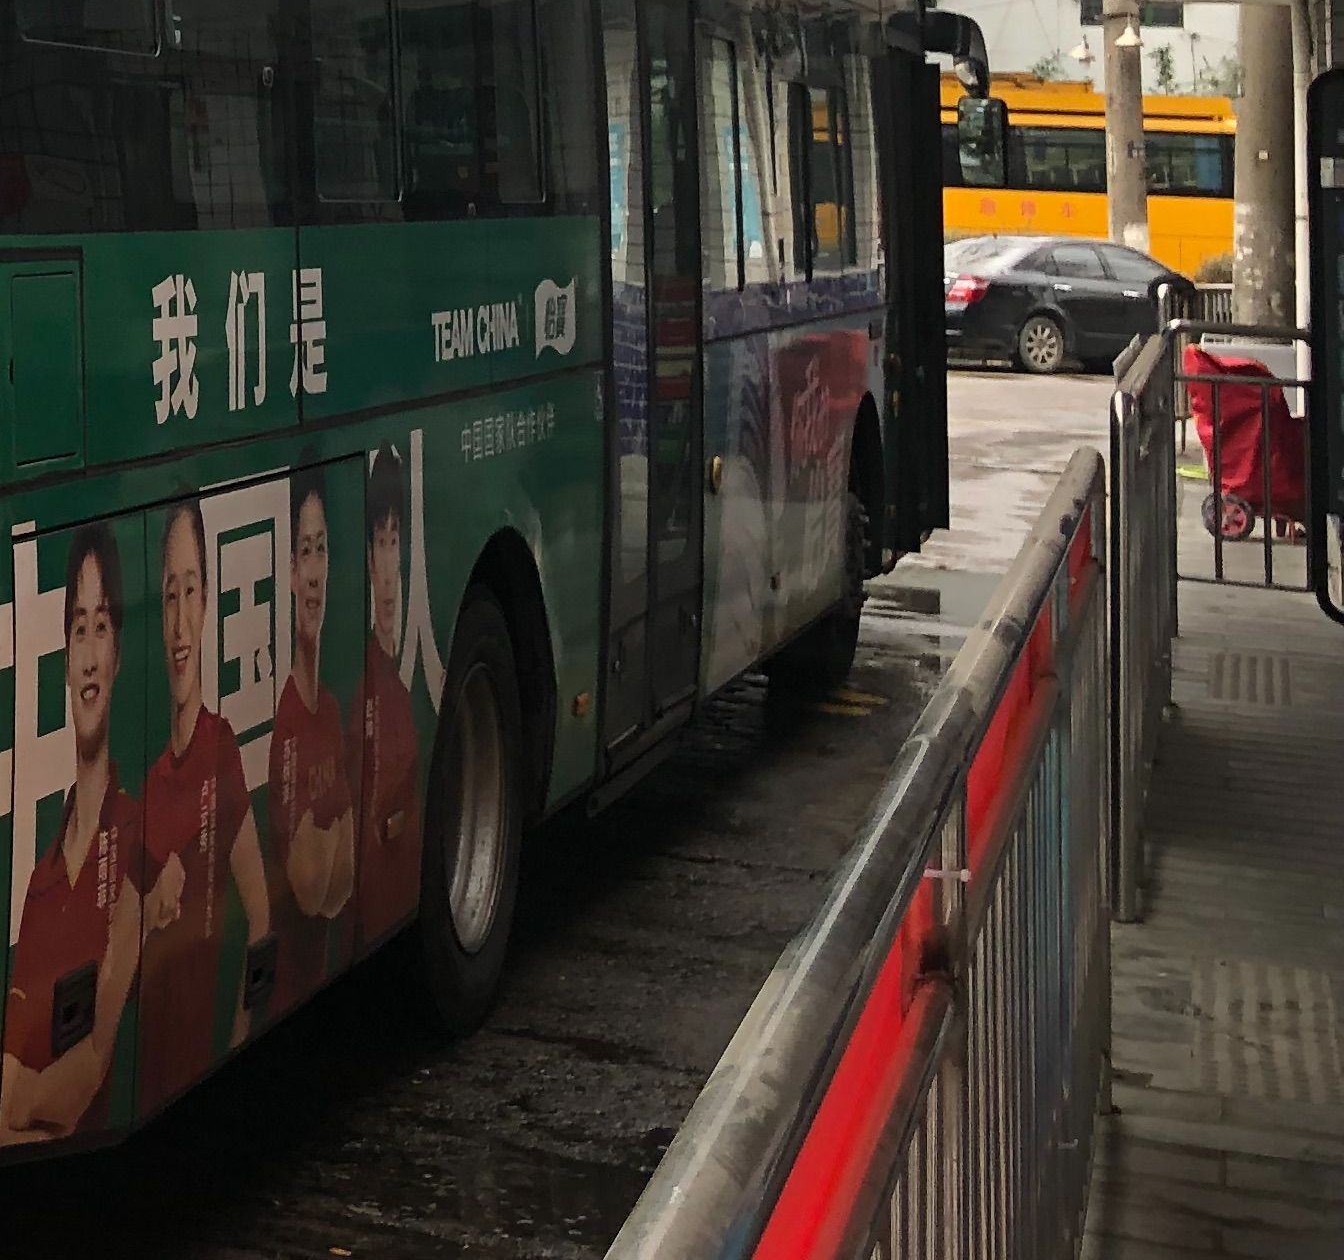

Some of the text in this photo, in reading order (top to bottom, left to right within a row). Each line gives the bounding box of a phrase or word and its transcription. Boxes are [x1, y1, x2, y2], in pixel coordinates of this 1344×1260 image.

[151, 267, 328, 425] 我们是
[431, 300, 520, 363] TEAM CHINA
